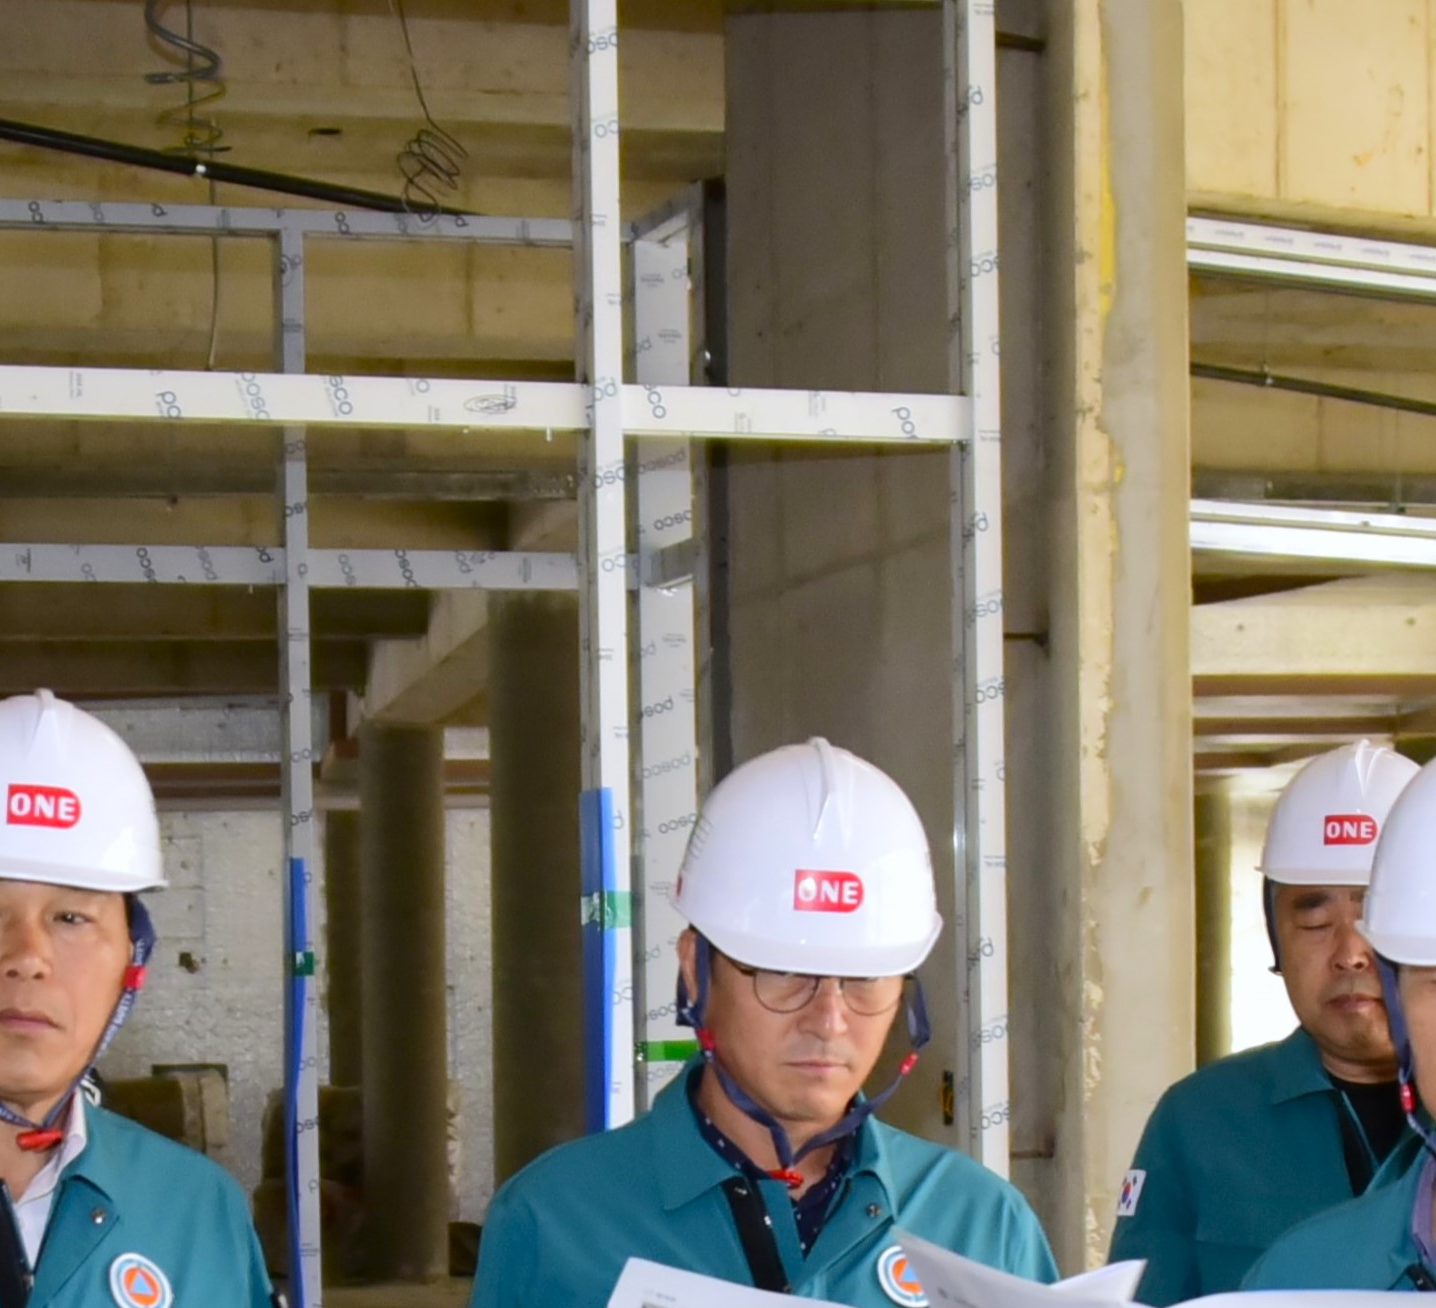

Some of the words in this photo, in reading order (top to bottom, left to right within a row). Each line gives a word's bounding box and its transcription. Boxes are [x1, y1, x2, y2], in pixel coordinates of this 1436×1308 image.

[11, 792, 75, 819] ONE
[1326, 821, 1373, 840] ONE
[798, 876, 859, 902] ONE
